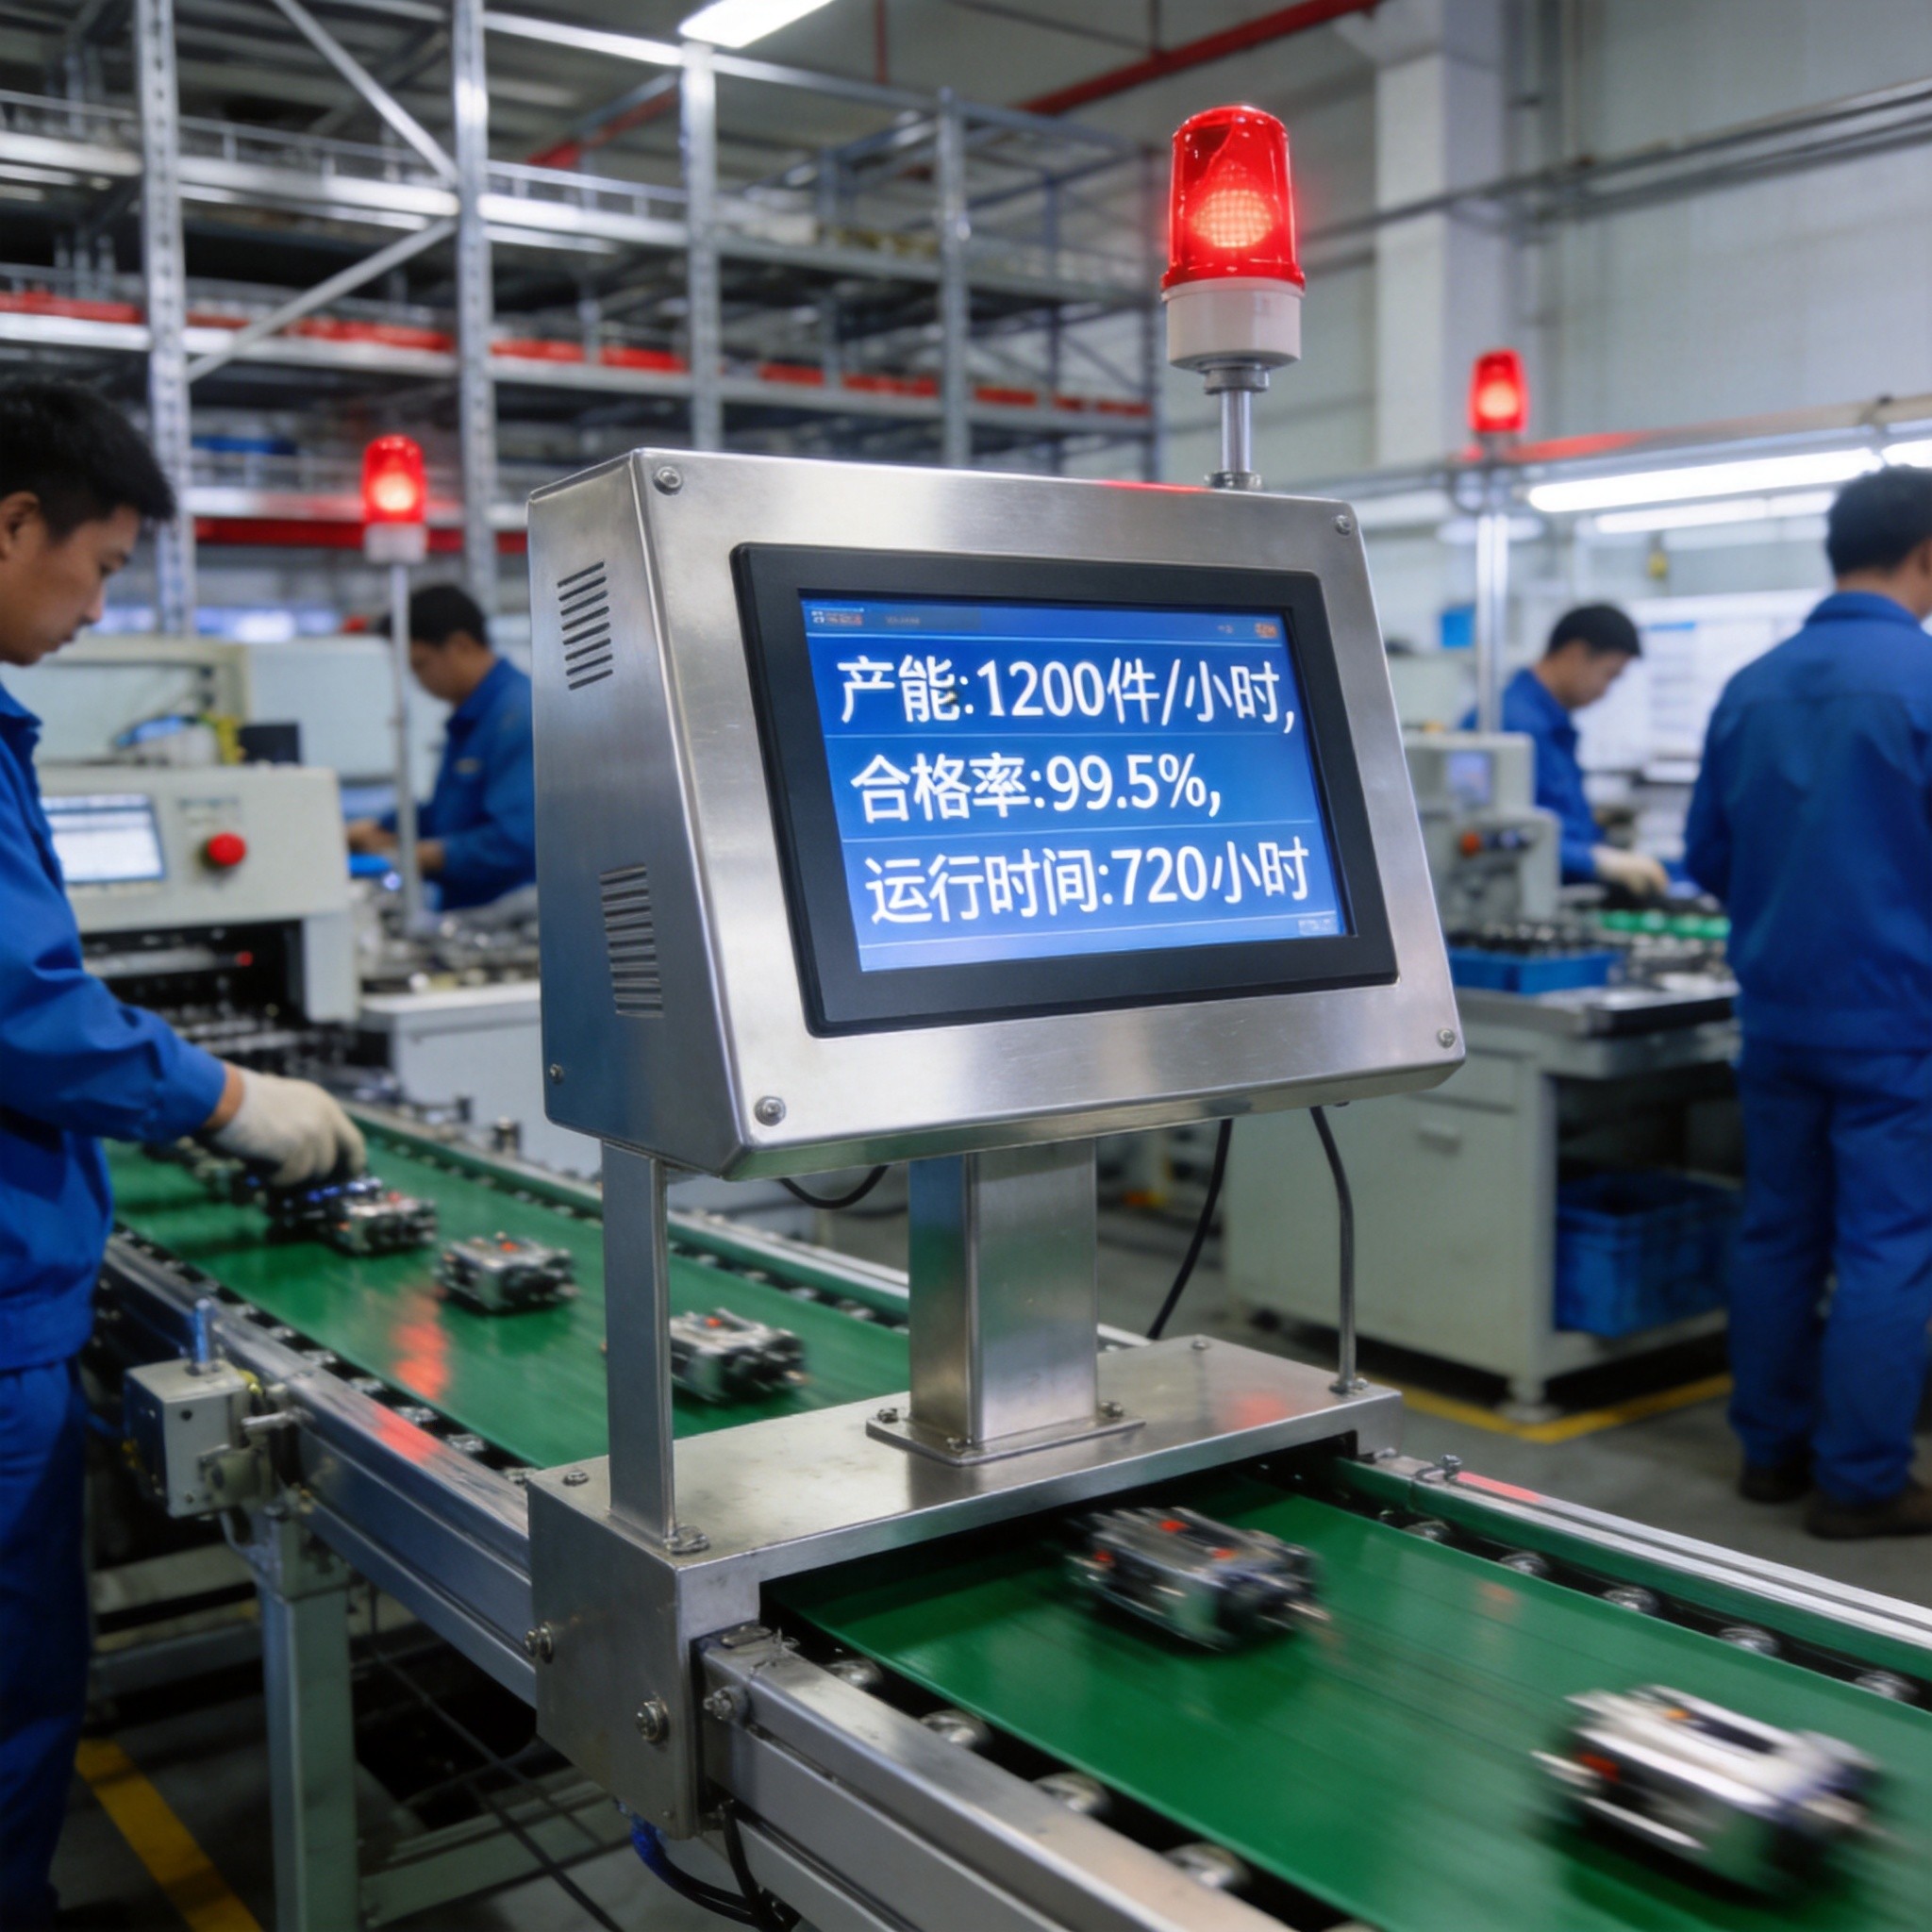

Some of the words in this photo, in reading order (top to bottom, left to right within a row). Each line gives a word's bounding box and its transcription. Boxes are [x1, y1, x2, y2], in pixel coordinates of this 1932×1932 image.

[850, 752, 1222, 824] 合格率:99.5%,
[864, 836, 1309, 924] 运行时间:720小时
